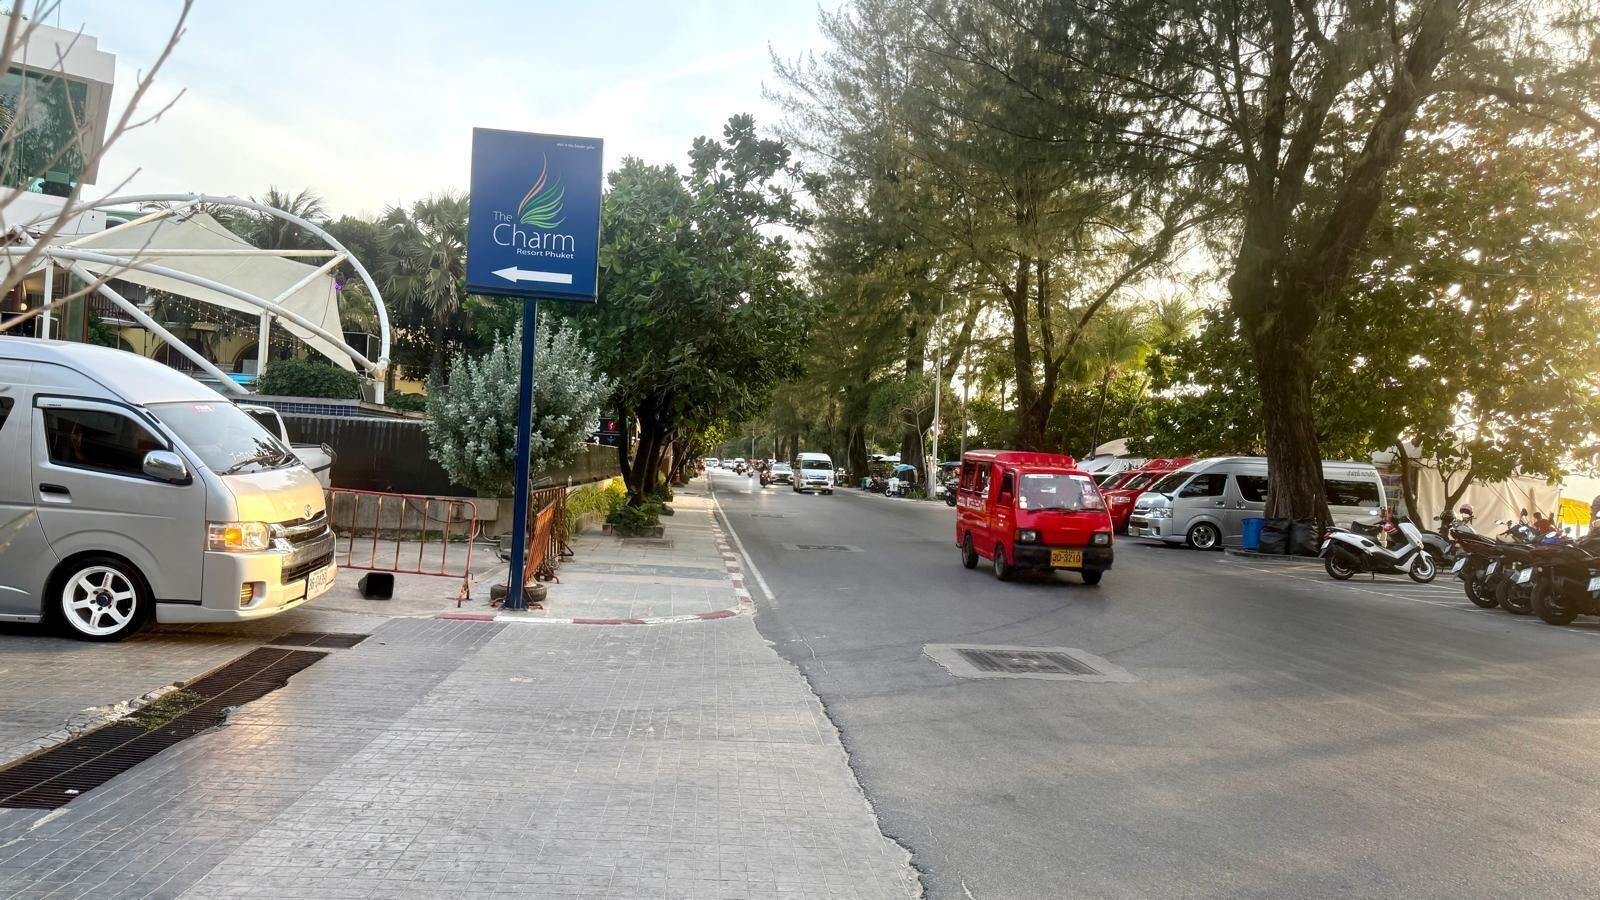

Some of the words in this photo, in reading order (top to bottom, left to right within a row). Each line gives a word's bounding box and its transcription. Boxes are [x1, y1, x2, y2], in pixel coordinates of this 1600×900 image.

[493, 211, 513, 222] The
[493, 223, 575, 252] Charm
[516, 248, 543, 257] Resort
[545, 250, 575, 259] Phuket
